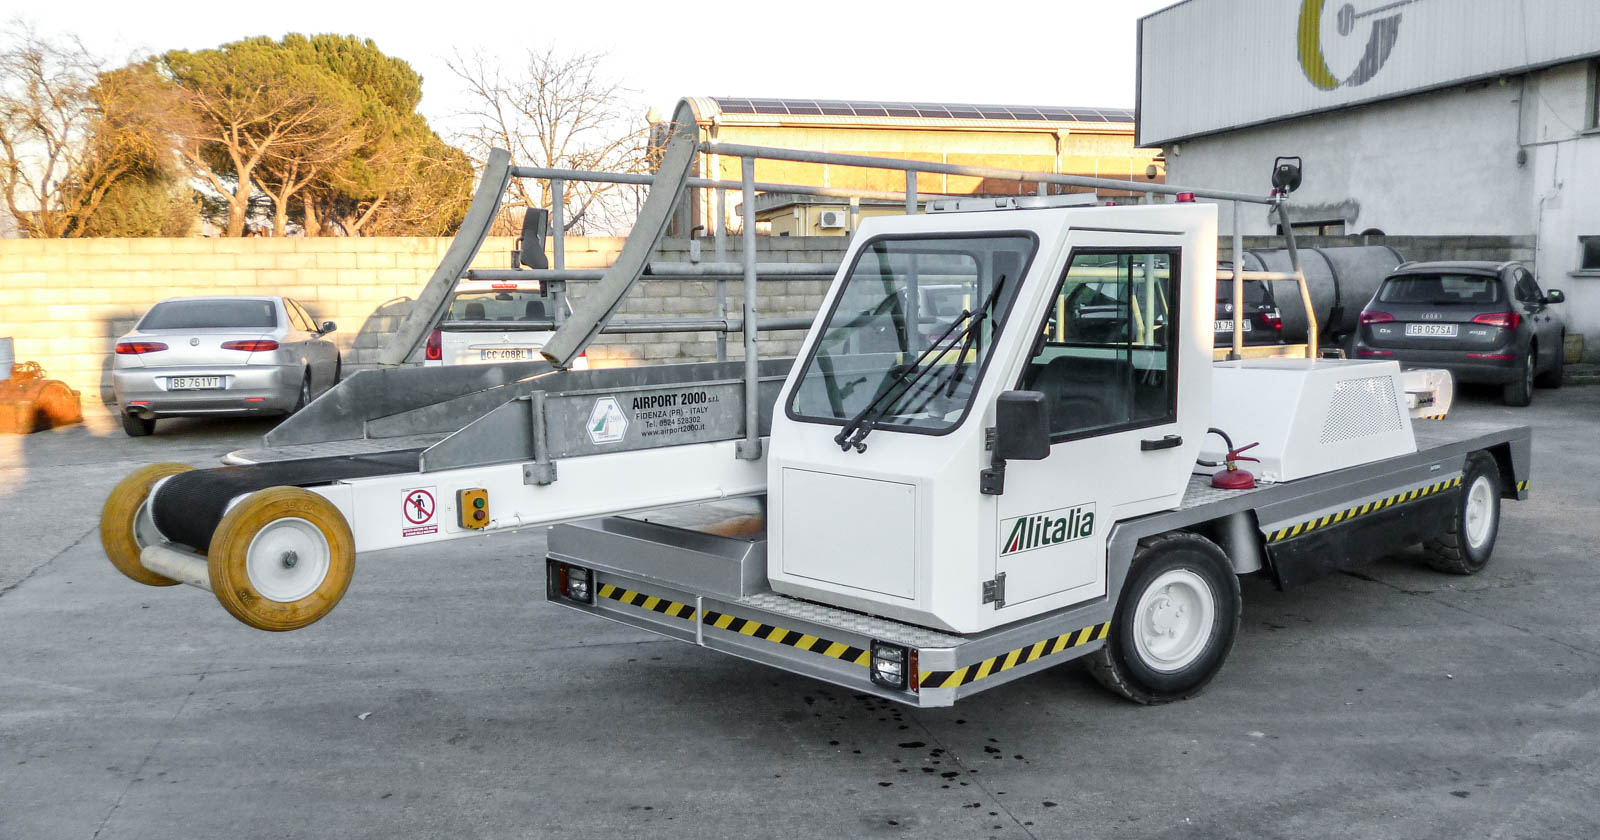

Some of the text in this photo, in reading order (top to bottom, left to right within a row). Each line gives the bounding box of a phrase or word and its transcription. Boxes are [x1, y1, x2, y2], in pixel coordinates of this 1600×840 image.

[1412, 325, 1451, 335] EB 057SA
[486, 350, 527, 359] CC 408RL
[173, 377, 219, 388] BB 761VT
[632, 394, 678, 410] AIRPORT
[680, 391, 707, 406] 2000
[636, 410, 667, 420] FIDENZA
[669, 408, 683, 418] (PR)
[690, 406, 708, 415] ITALY
[645, 416, 701, 429] Tel. 0524 528302
[641, 424, 705, 437] www.airport2000.it
[1001, 507, 1095, 555] Alitalia
